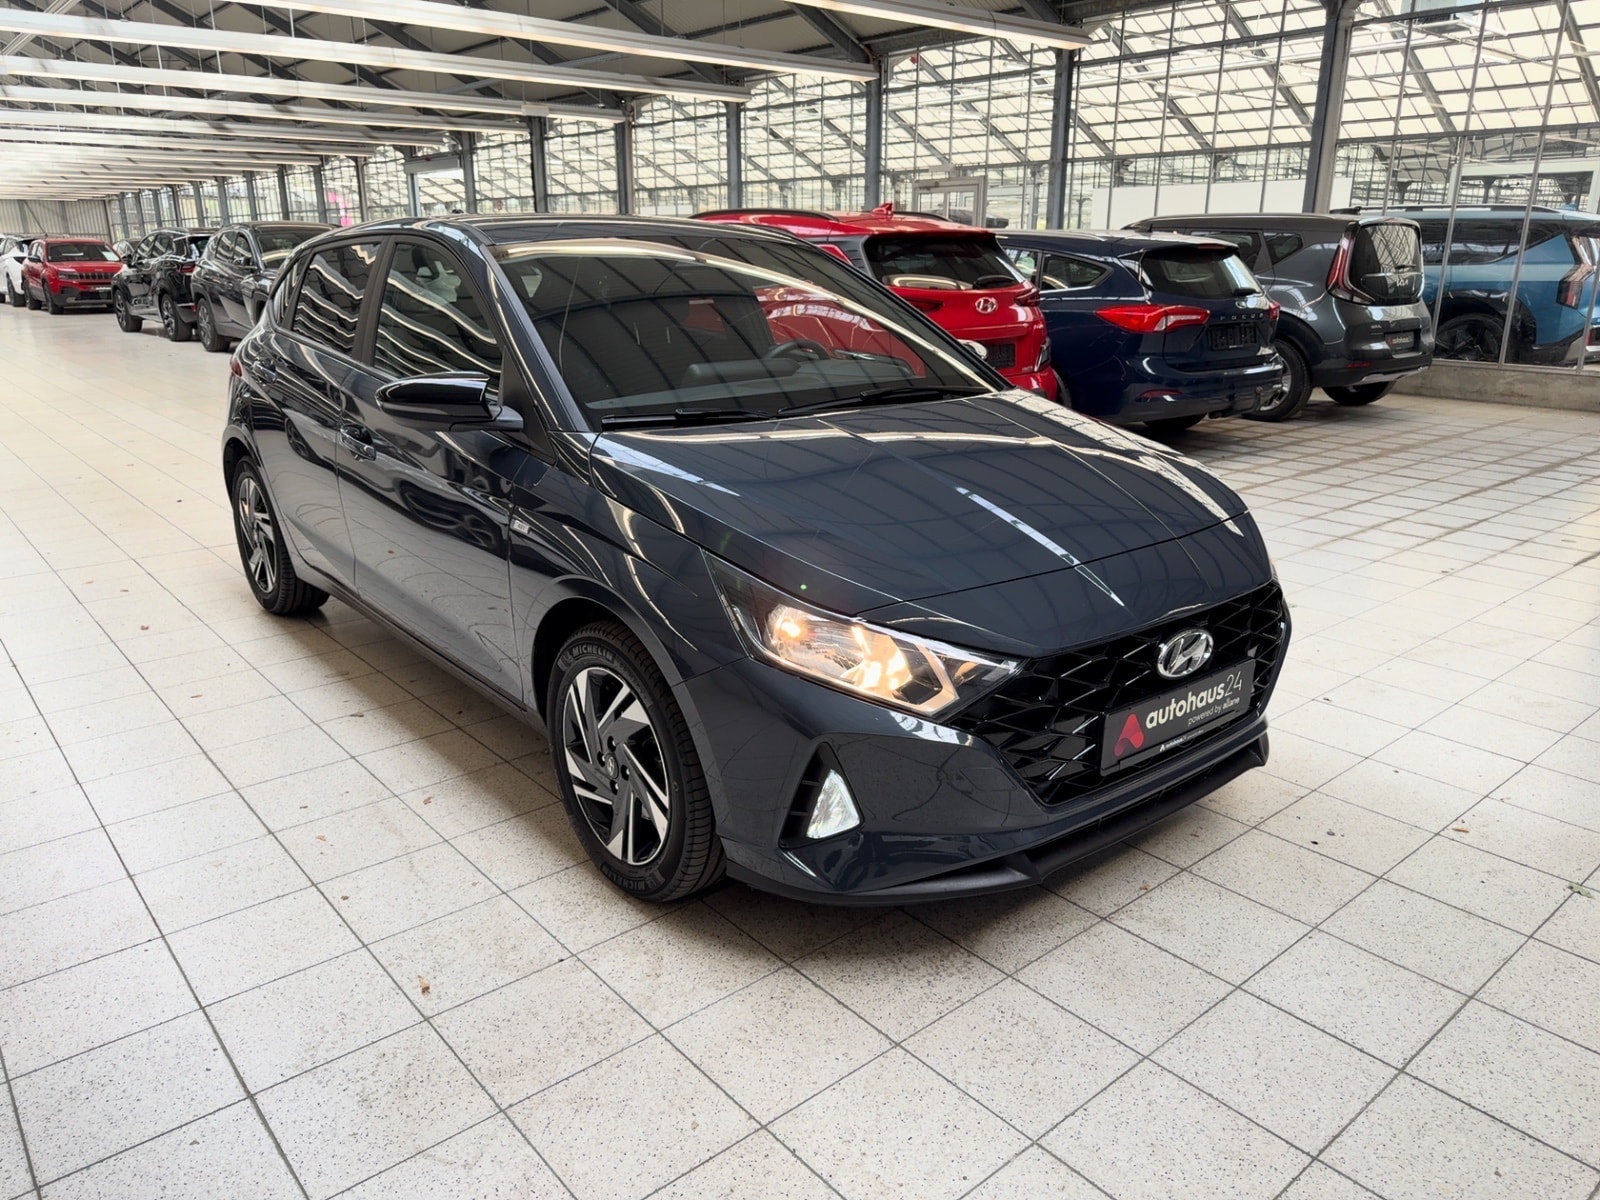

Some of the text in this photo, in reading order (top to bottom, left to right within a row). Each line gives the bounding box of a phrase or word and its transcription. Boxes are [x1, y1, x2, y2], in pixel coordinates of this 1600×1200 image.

[572, 644, 615, 661] MICHELIN
[1145, 671, 1243, 729] autohaus24
[1188, 706, 1214, 728] powered
[1214, 704, 1223, 714] by
